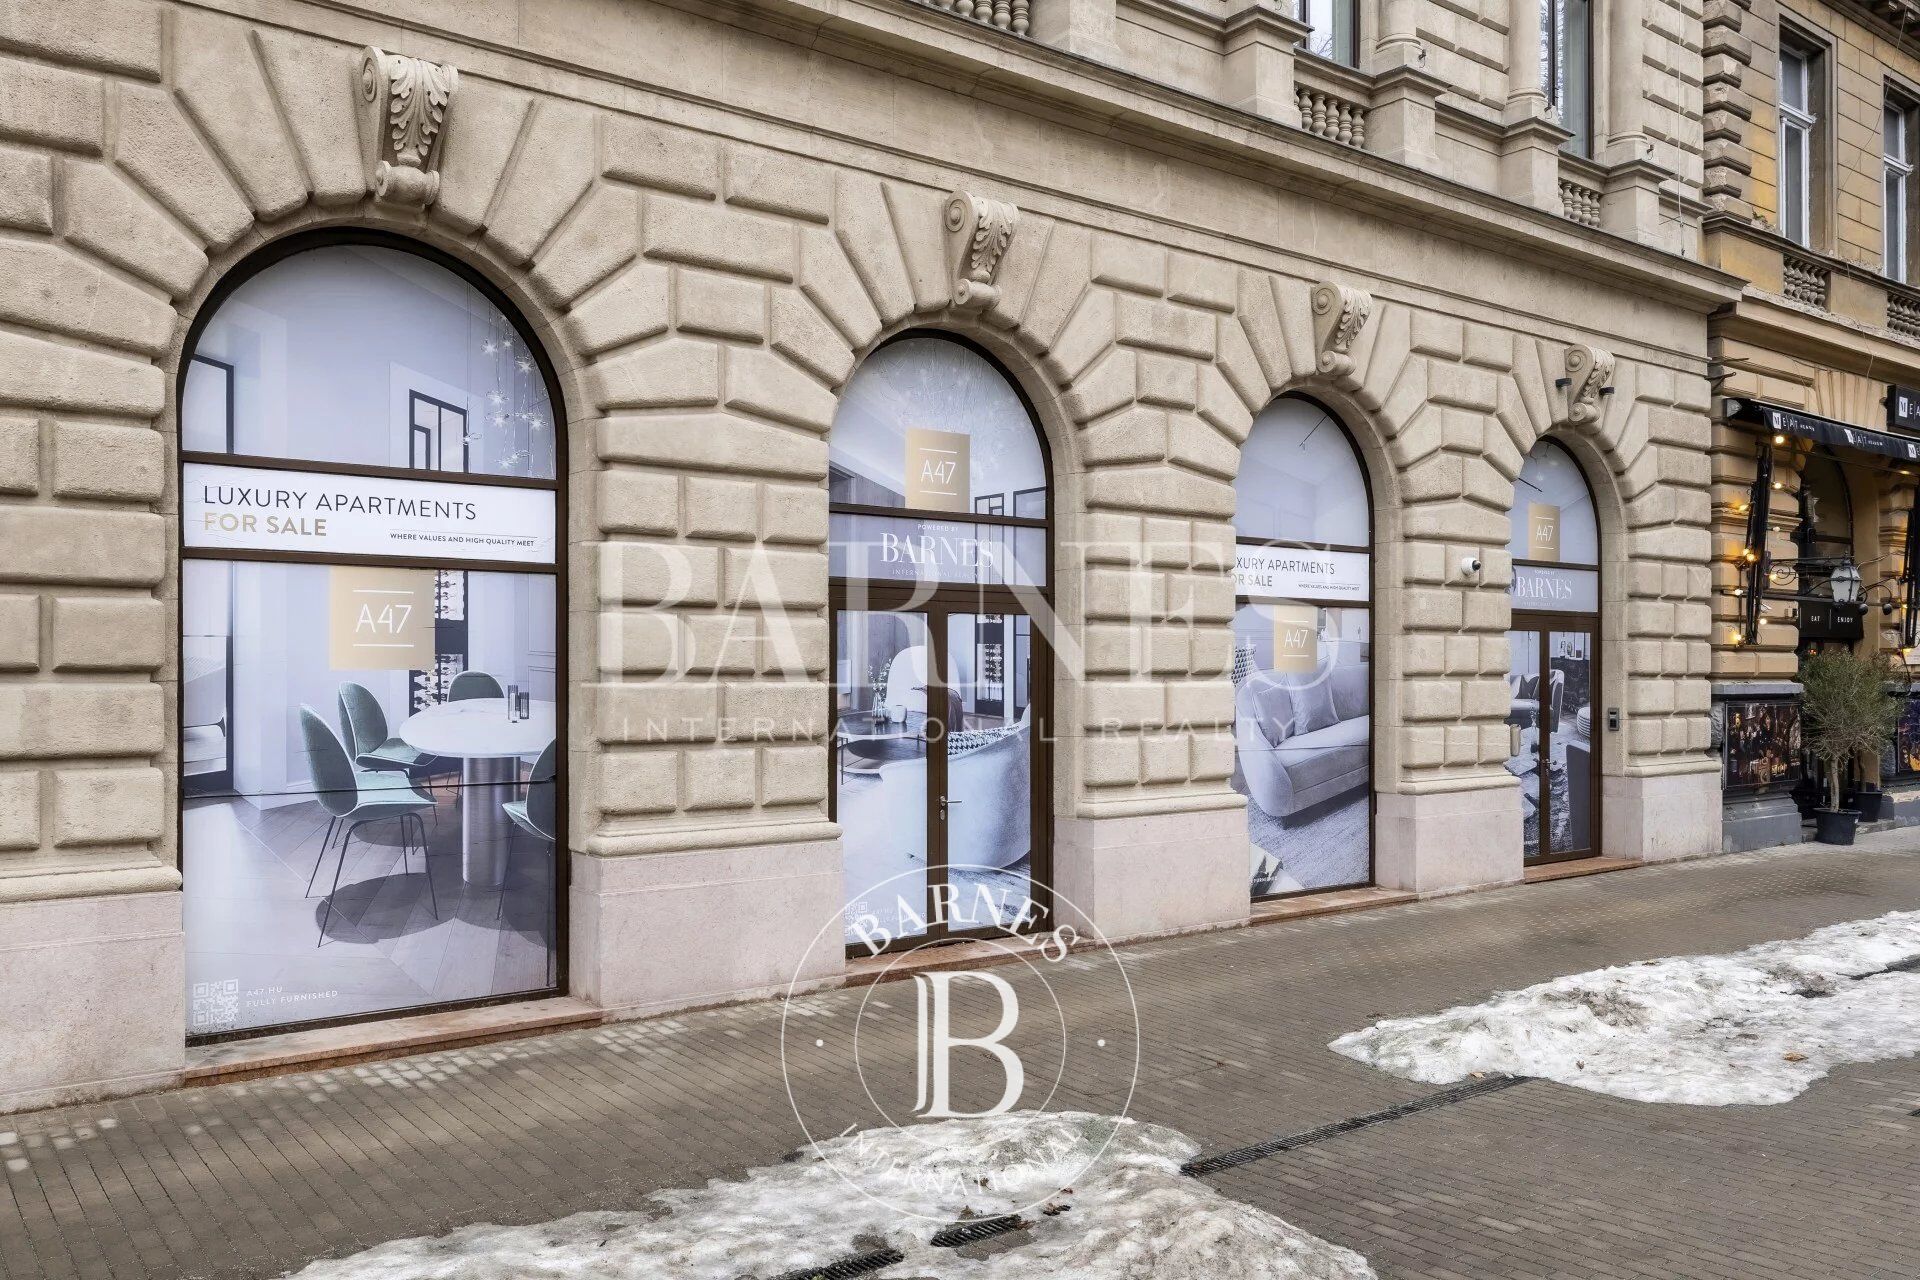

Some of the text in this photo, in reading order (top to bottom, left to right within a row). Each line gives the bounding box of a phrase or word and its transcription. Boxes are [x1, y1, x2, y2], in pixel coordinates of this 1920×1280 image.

[920, 460, 956, 484] A47
[204, 485, 476, 520] LUXURY APARTMENTS
[204, 512, 327, 537] FOR SALE
[1536, 524, 1554, 542] A47
[390, 533, 417, 541] WHERE
[419, 534, 446, 542] VALUES
[486, 538, 515, 546] QUALITY
[880, 532, 994, 568] BARNES
[1268, 559, 1335, 574] APARTMENTS
[1248, 574, 1272, 587] SALE
[1516, 576, 1572, 600] BARNES
[355, 603, 412, 634] A47
[1284, 629, 1308, 649] A47
[246, 990, 338, 1007] FULLY FURNISHED
